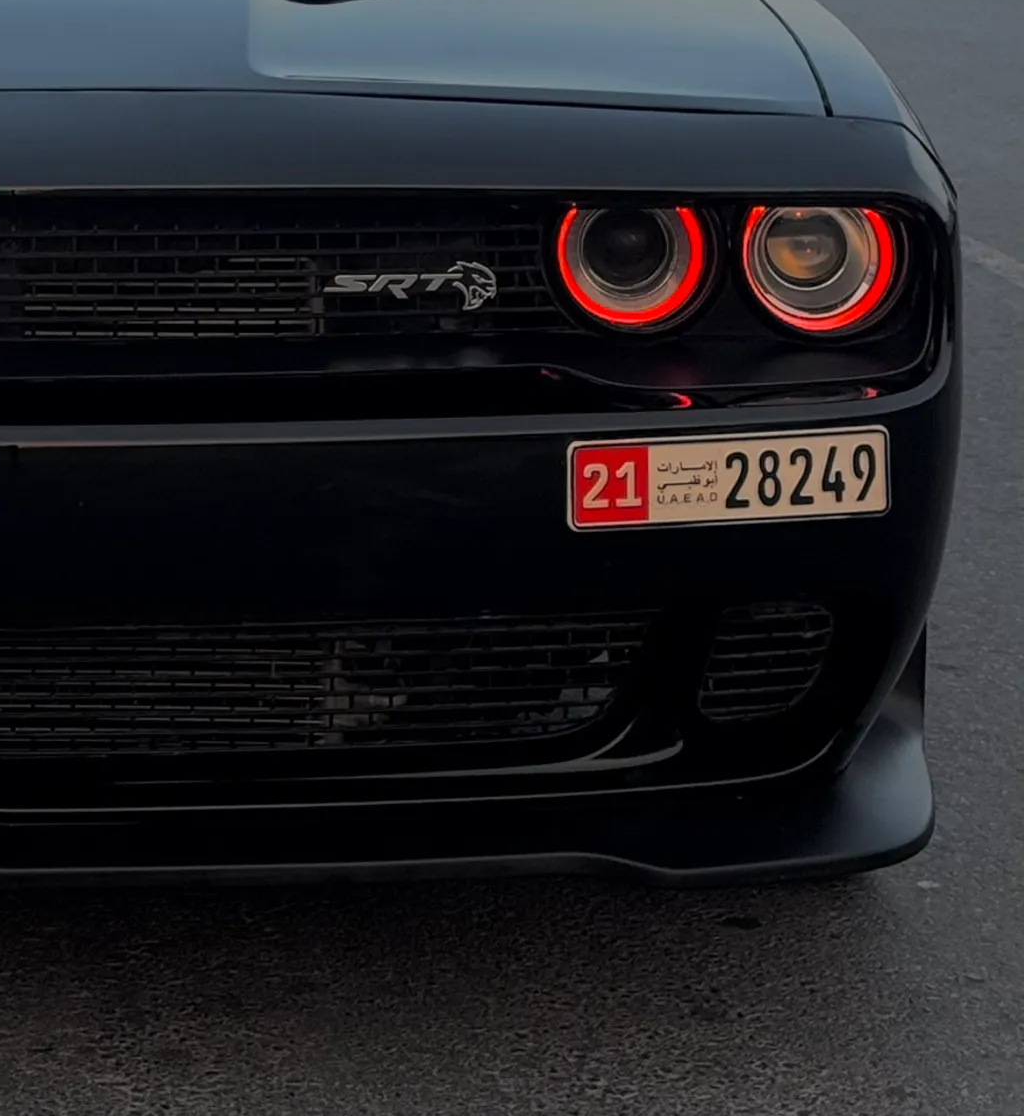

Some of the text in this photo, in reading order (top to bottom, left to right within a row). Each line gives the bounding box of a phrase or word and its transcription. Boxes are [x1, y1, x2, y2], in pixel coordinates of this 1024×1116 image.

[322, 273, 463, 299] SRT
[582, 461, 643, 510] 21
[725, 443, 877, 510] 28249
